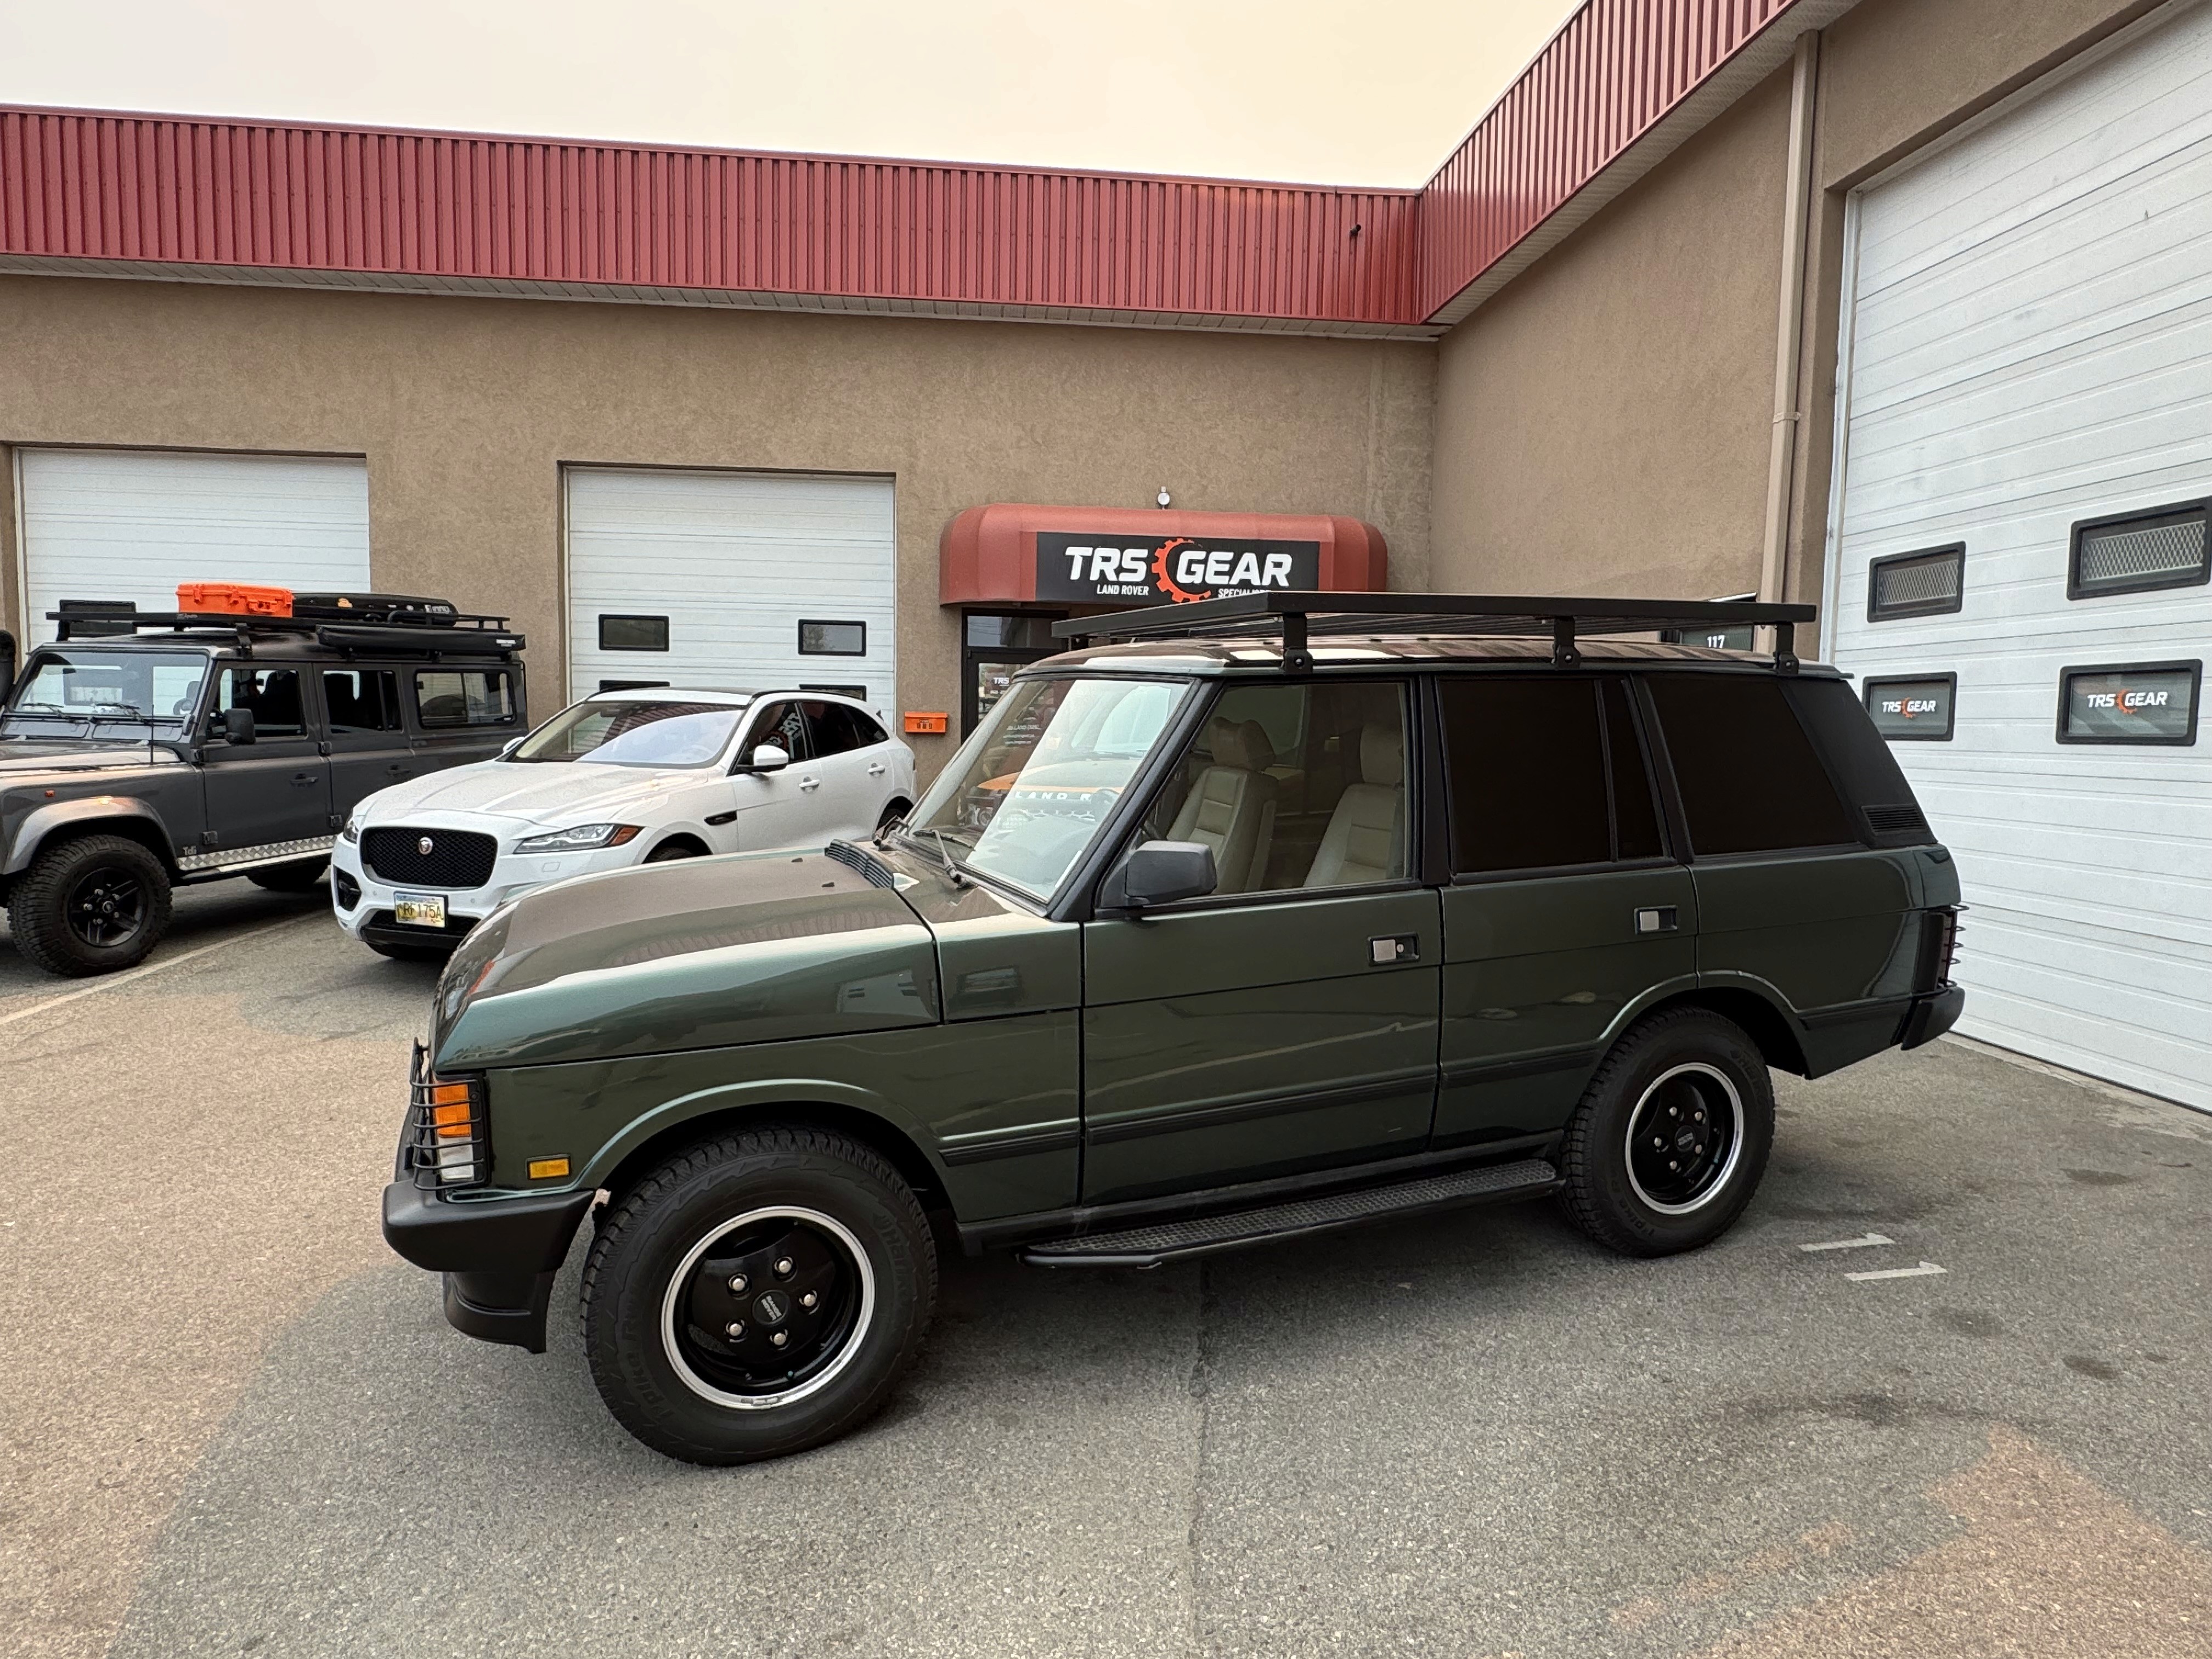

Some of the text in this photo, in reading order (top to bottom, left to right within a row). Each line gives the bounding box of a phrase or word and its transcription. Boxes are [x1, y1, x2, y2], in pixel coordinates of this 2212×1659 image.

[1065, 546, 1293, 586] TRS GEAR
[1097, 584, 1119, 595] LAND
[1121, 585, 1149, 596] ROVER
[1707, 634, 1726, 648] 117
[2087, 691, 2168, 708] TRS GEAR
[1882, 700, 1936, 713] TRS GEAR
[1015, 791, 1068, 800] LAND
